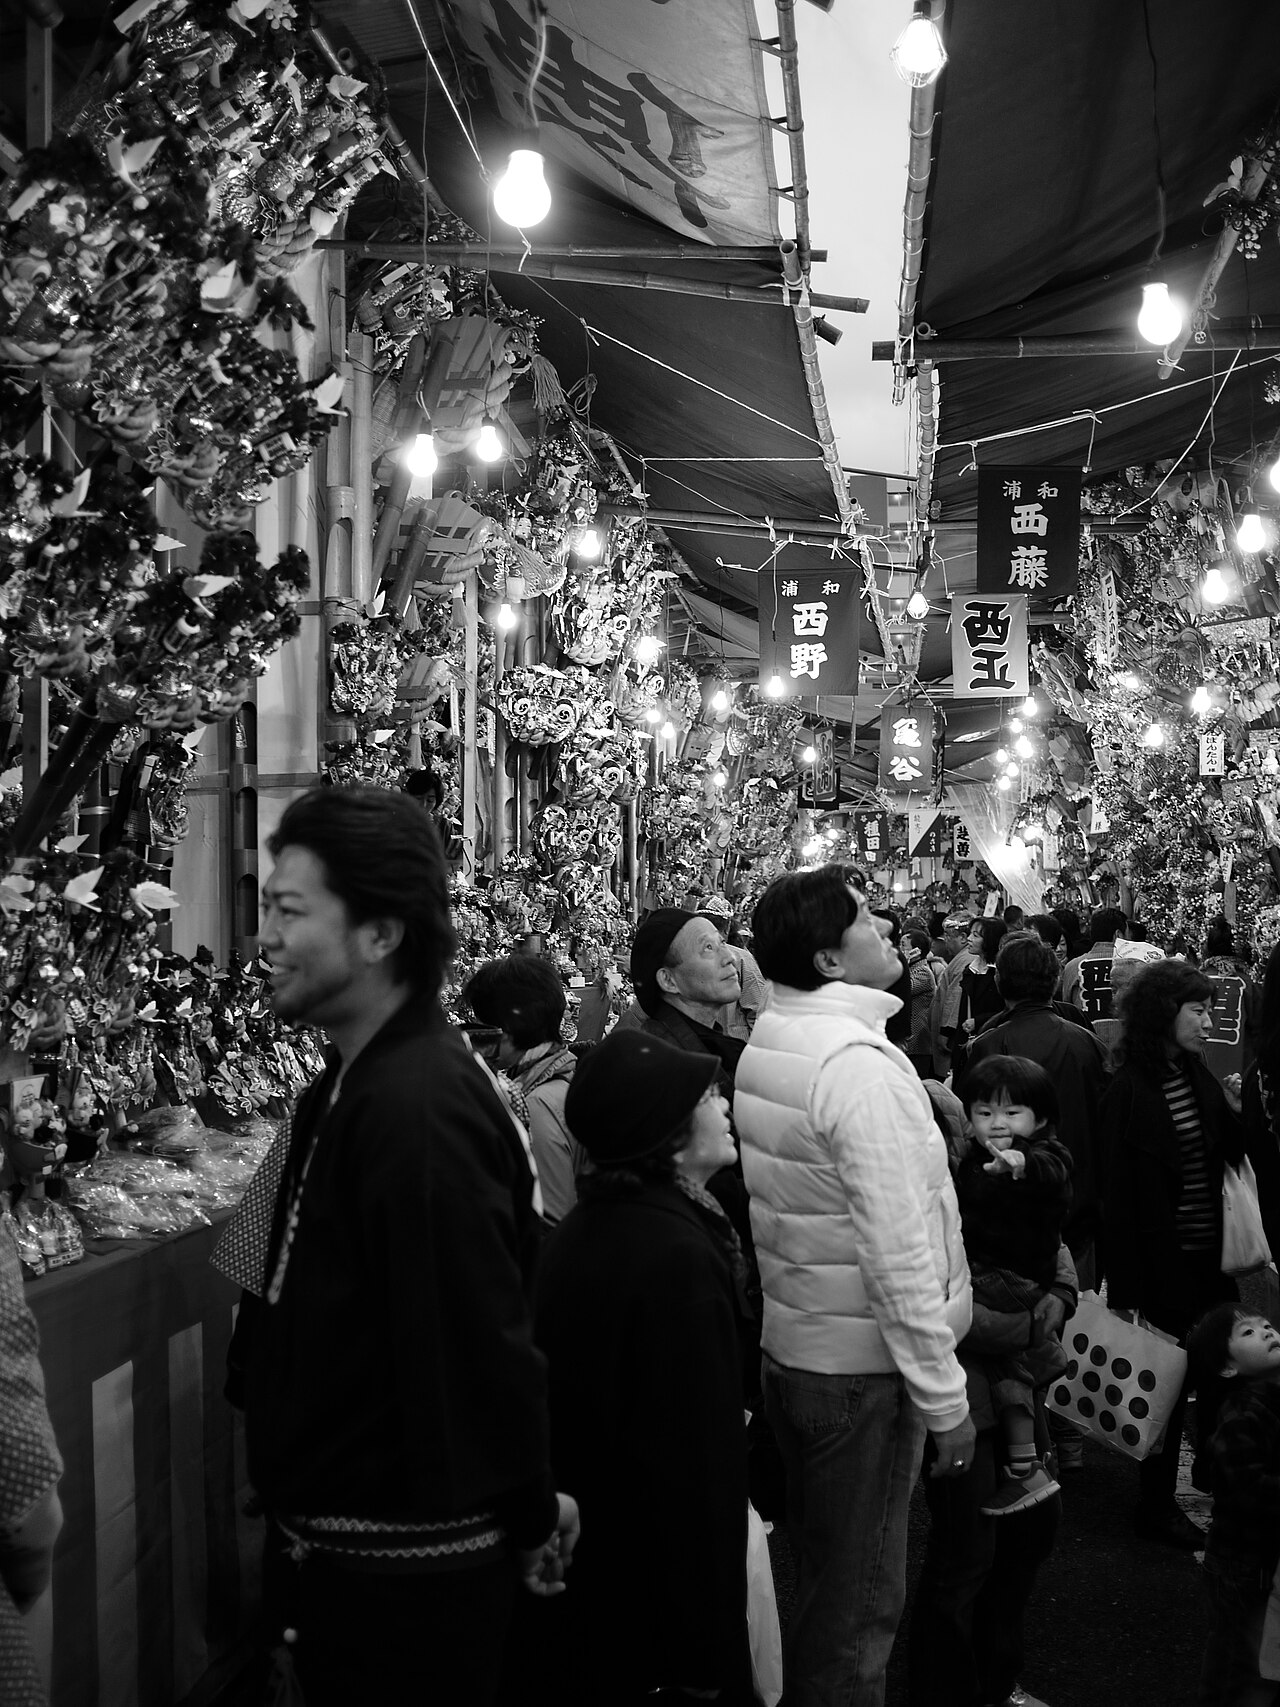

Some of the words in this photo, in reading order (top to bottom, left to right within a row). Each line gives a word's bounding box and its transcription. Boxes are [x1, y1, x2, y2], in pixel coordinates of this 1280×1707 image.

[1002, 480, 1059, 500] 浦和
[1007, 502, 1049, 589] 西藤
[781, 580, 840, 597] 浦和
[789, 601, 829, 680] 西野
